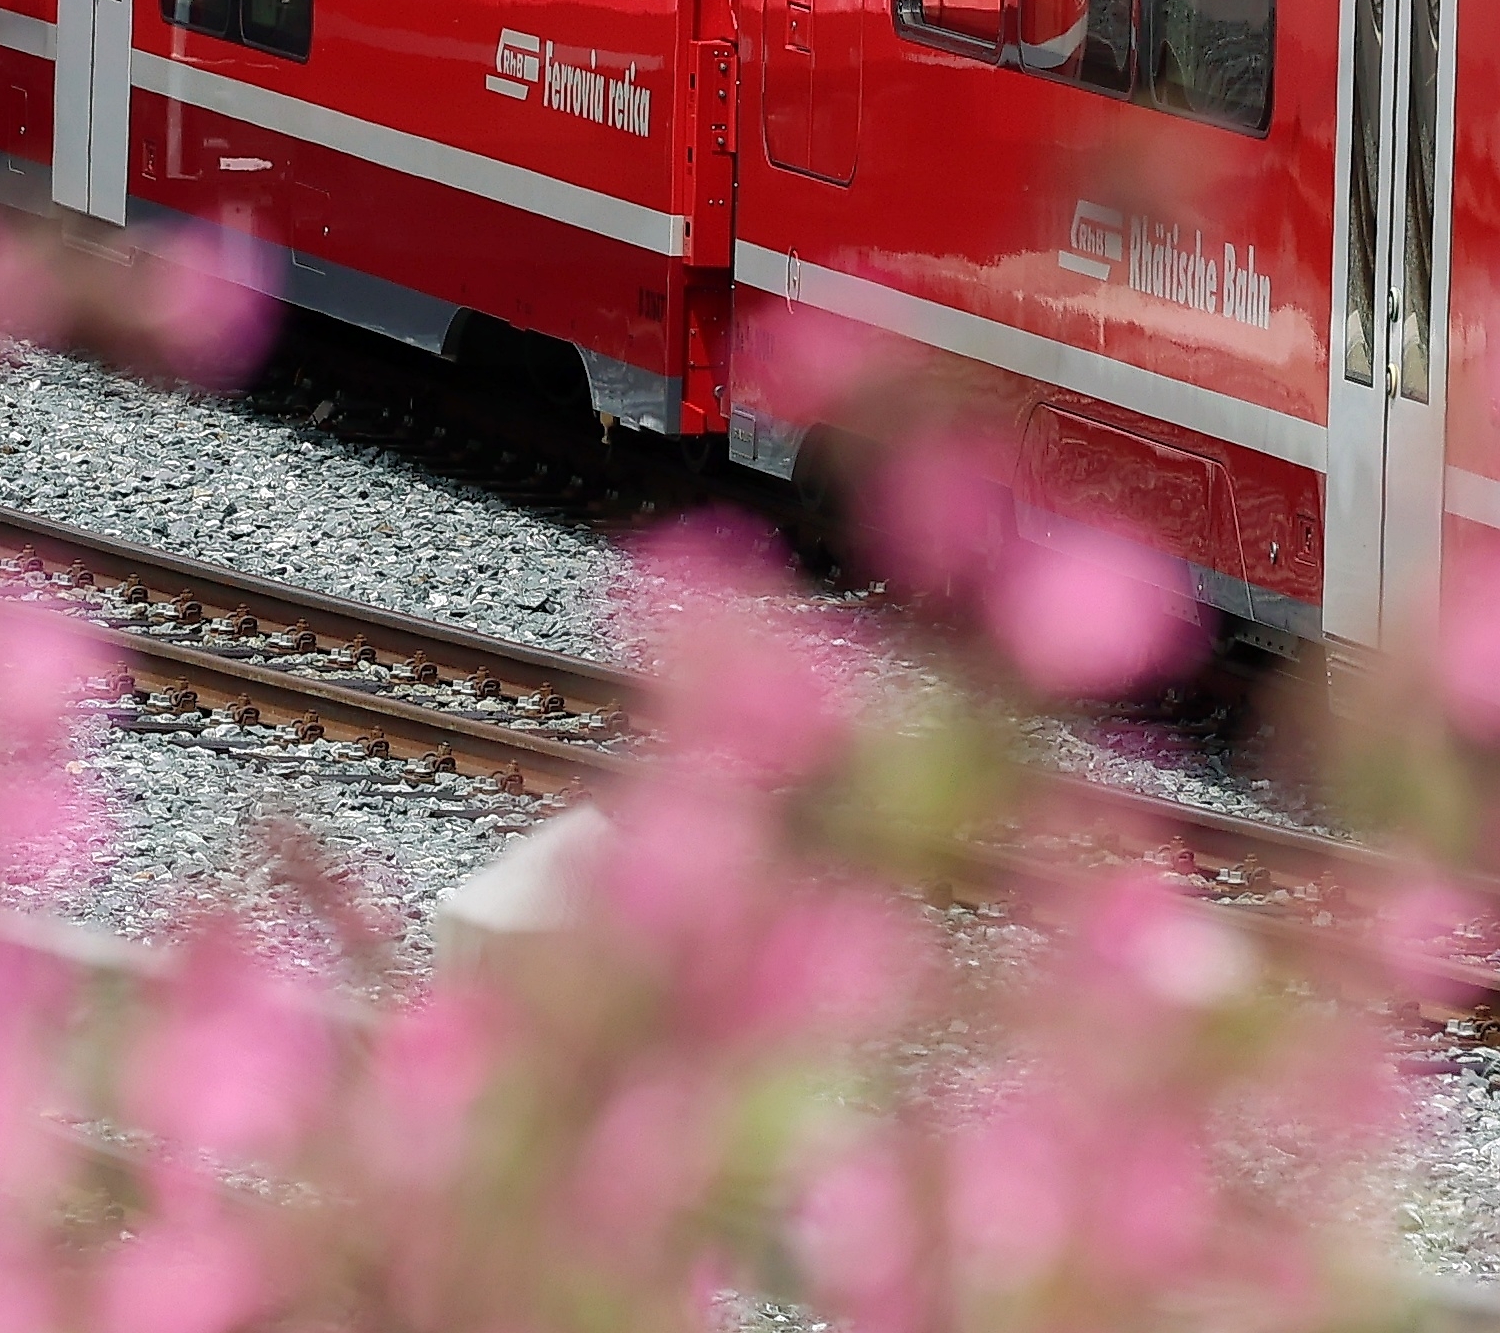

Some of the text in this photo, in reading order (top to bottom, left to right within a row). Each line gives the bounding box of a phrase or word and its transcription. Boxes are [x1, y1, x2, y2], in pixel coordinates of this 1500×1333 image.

[543, 40, 605, 124] Ferrovia
[607, 61, 651, 138] retica
[1129, 214, 1217, 314] Rhätische
[1223, 242, 1270, 330] Bahn
